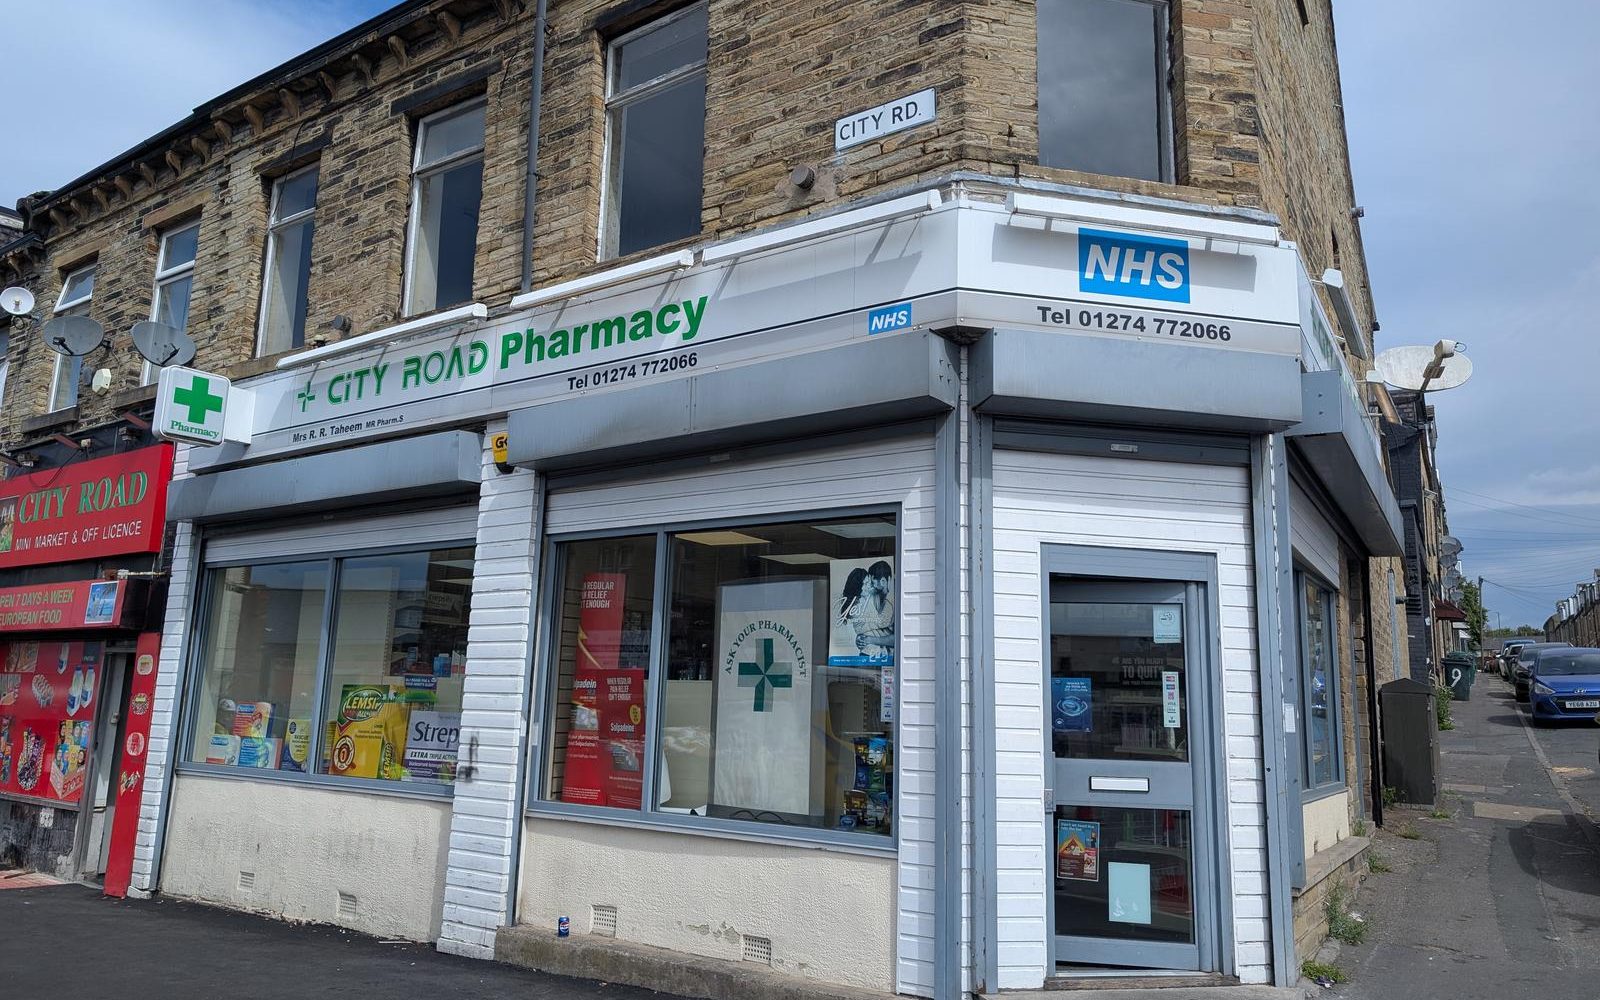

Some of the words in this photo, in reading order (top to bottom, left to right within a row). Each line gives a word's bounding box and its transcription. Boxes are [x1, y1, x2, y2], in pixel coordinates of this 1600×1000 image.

[839, 111, 884, 140] CITY
[891, 101, 921, 125] RD.
[1083, 244, 1185, 290] NHS
[870, 309, 909, 331] NHS
[1037, 305, 1071, 325] Tel
[1078, 310, 1147, 332] 01274
[1152, 319, 1232, 341] 772066
[402, 341, 490, 390] ROAD
[500, 296, 709, 370] Pharmacy
[568, 374, 588, 390] Tel
[592, 364, 637, 387] 01274
[641, 352, 698, 377] 772066
[170, 420, 220, 439] Pharmacy
[292, 432, 307, 443] Mrs
[309, 430, 318, 439] R.
[319, 428, 328, 438] R.
[330, 422, 363, 437] Taheem
[19, 485, 73, 524] CITY
[77, 470, 149, 515] ROAD
[15, 538, 32, 551] MINI
[34, 531, 69, 549] MARKET
[71, 530, 78, 545] &
[81, 527, 99, 543] OFF
[102, 520, 143, 540] LICENCE
[21, 591, 42, 606] DAYS
[42, 591, 49, 604] A
[50, 588, 74, 604] WEEK
[586, 599, 610, 609] ENOUGH
[0, 610, 38, 626] EUROPEAN
[38, 609, 62, 625] FOOD
[725, 648, 737, 675] ASK
[733, 623, 757, 648] YOUR
[758, 620, 807, 678] PHARMACIST
[1122, 665, 1134, 678] TO
[1450, 667, 1462, 688] 9
[413, 721, 459, 749] Strep
[410, 751, 428, 759] EXTRA
